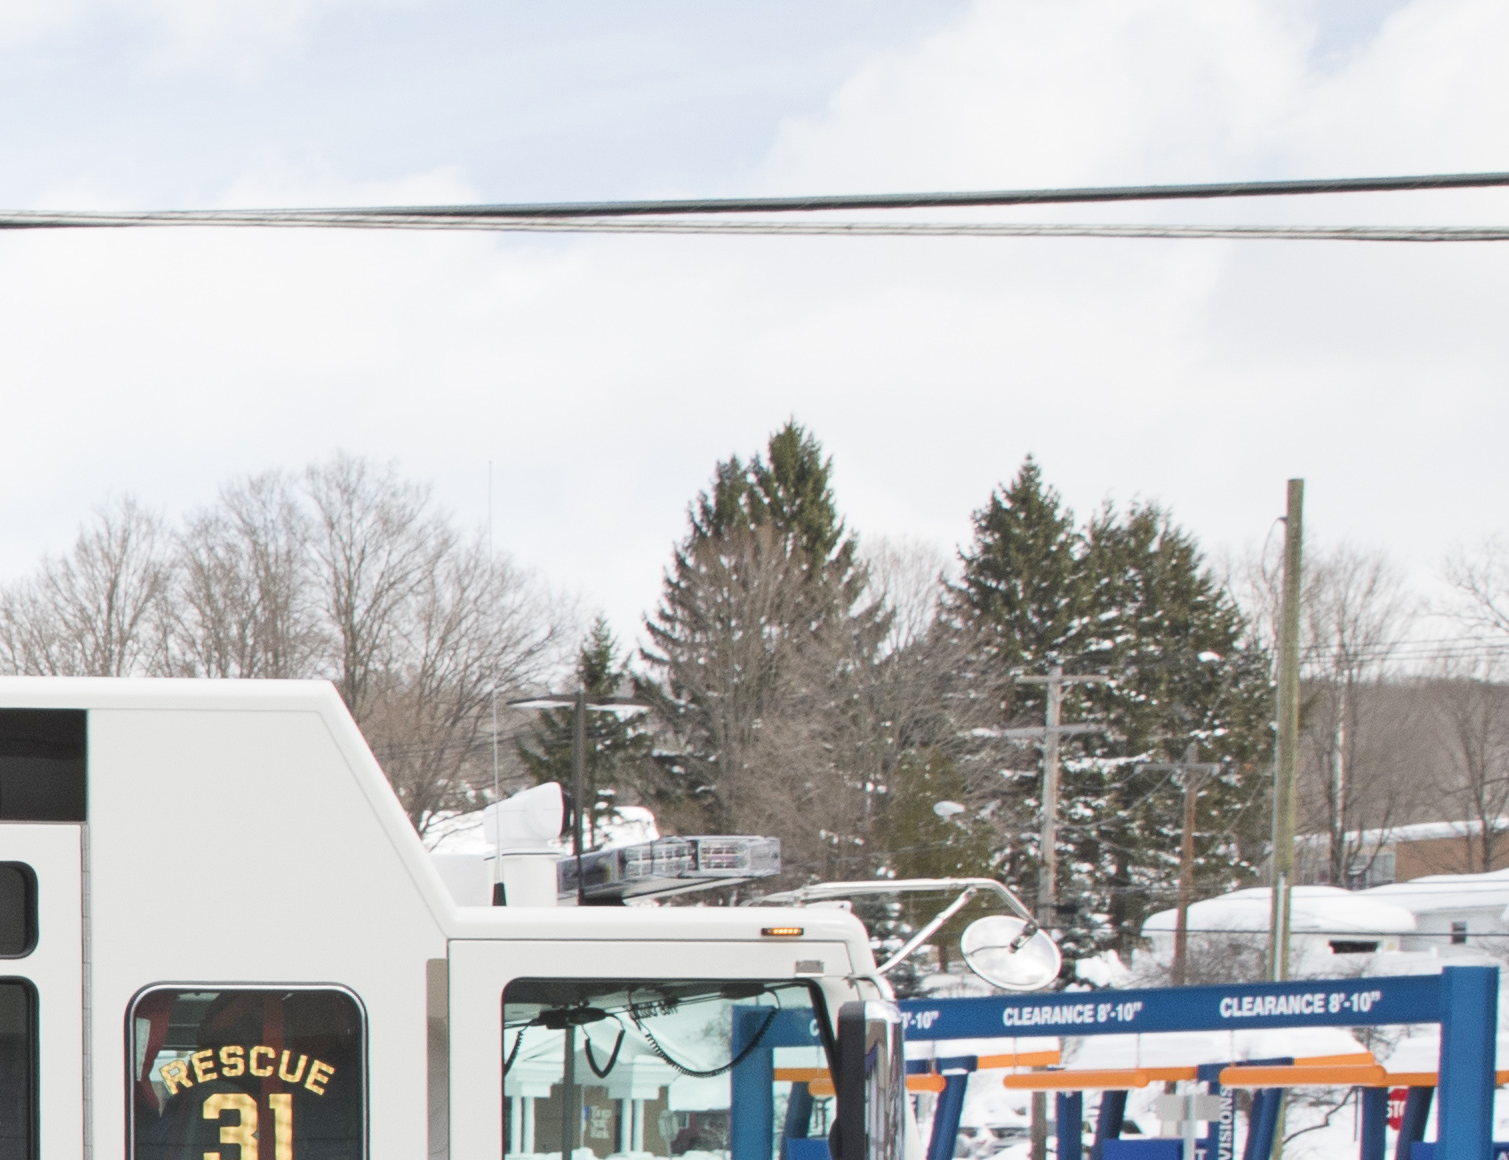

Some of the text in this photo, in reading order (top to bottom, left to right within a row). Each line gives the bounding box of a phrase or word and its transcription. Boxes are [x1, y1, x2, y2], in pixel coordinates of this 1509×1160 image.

[1003, 1007, 1094, 1026] CLEARANCE
[1220, 993, 1325, 1018] CLEARANCE
[159, 1045, 335, 1096] RESCUE
